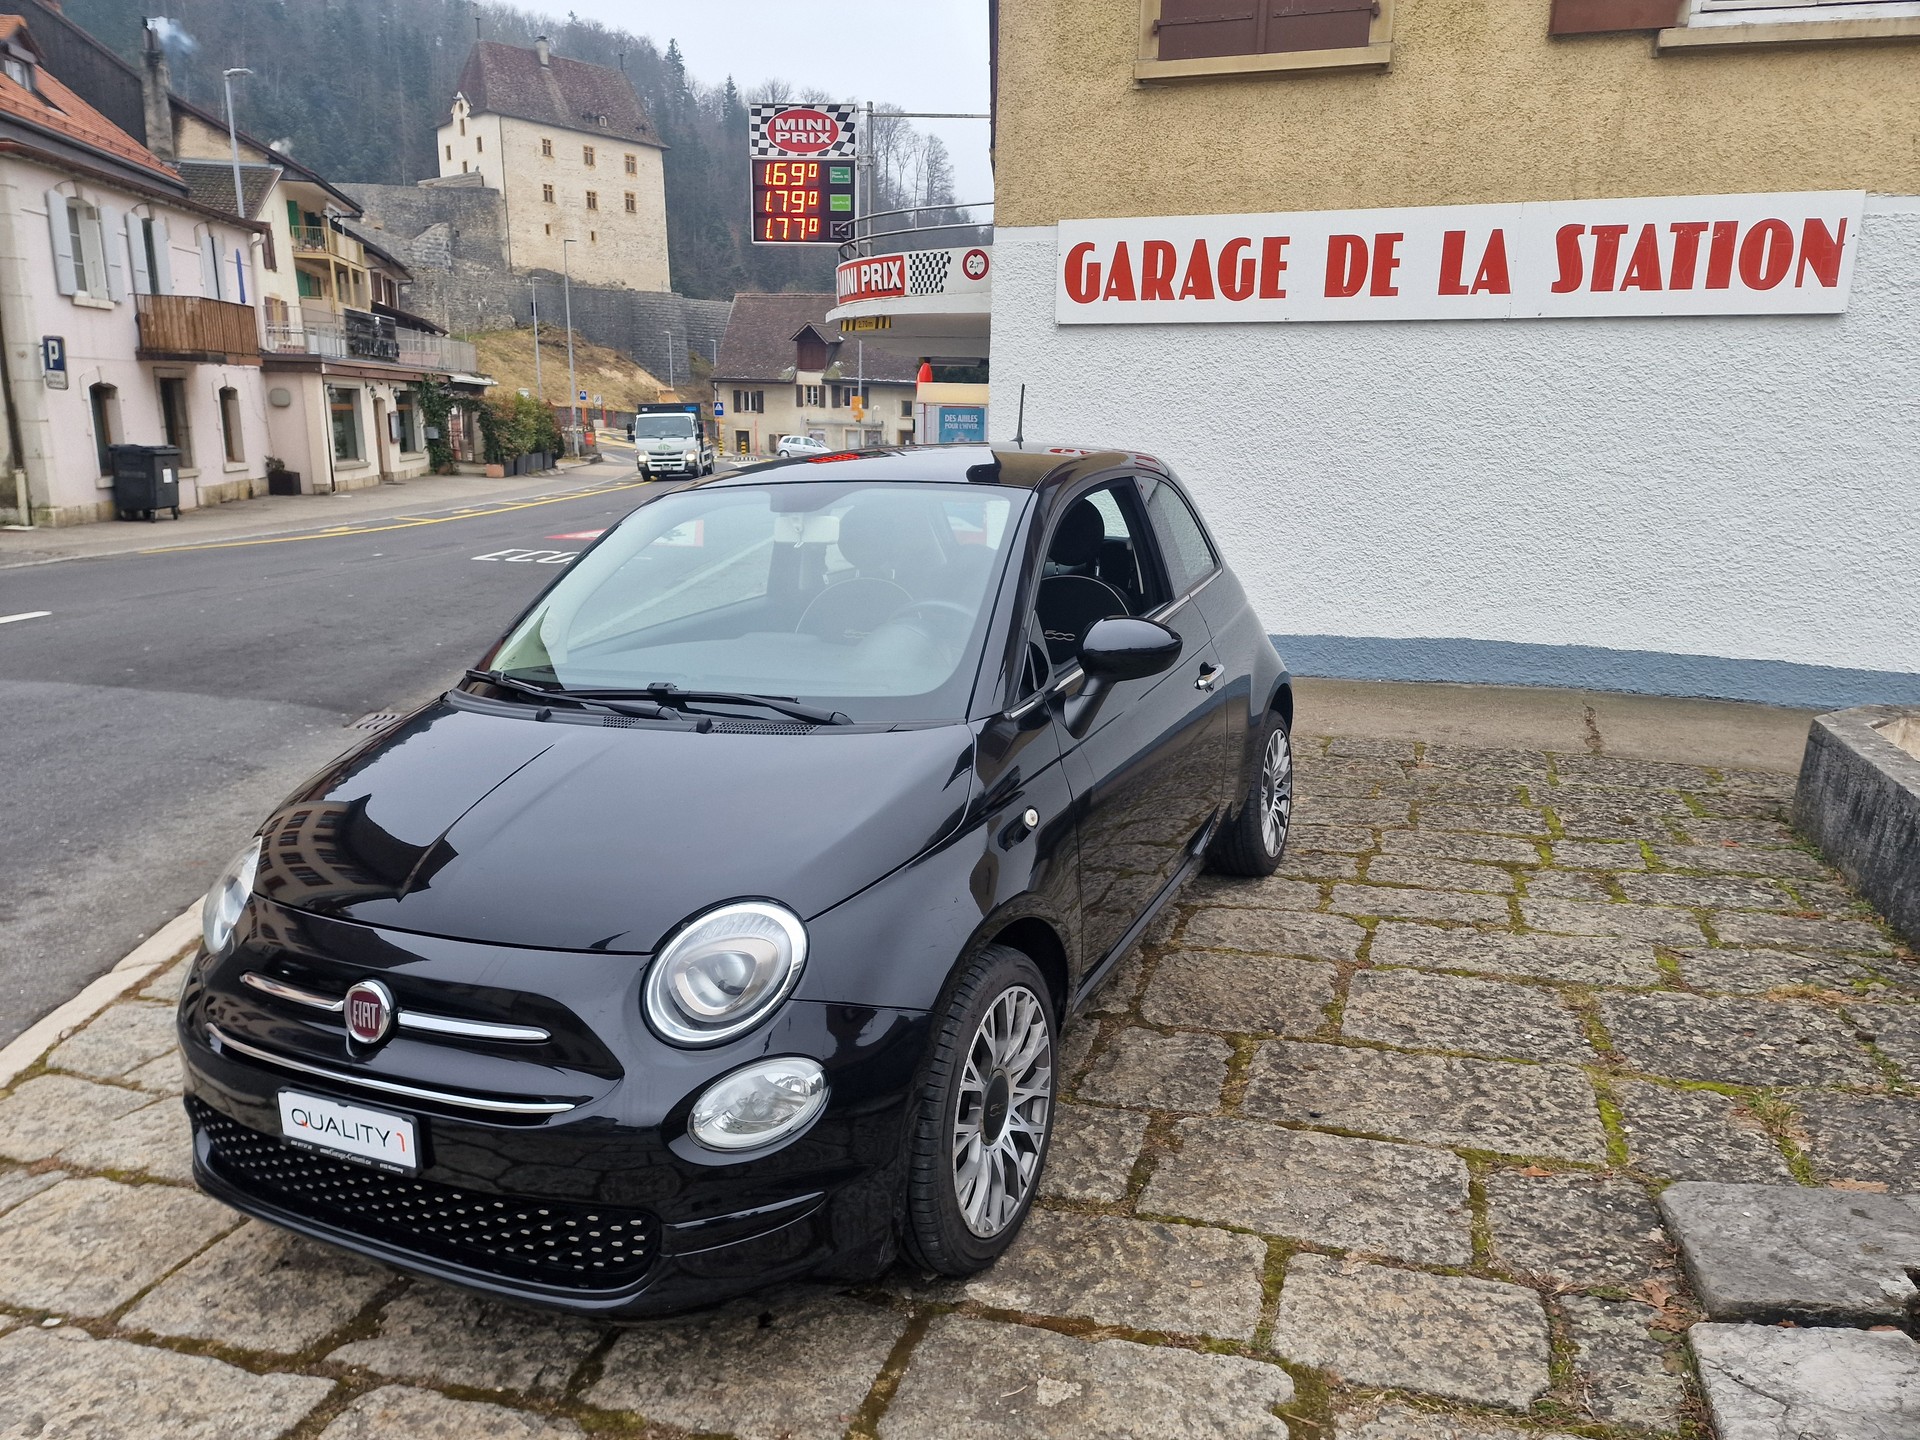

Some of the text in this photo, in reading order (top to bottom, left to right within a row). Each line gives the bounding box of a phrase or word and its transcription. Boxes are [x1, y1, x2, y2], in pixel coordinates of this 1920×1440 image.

[775, 118, 831, 131] MINI
[775, 131, 832, 144] PRIX
[1063, 217, 1848, 304] GARAGE DE LA STATION
[838, 260, 902, 297] MINI PRIX
[47, 339, 60, 369] P
[944, 414, 957, 423] DES
[944, 422, 959, 430] POUR
[1044, 629, 1076, 641] 500
[352, 999, 379, 1030] FIAT
[291, 1108, 391, 1148] QUALITY
